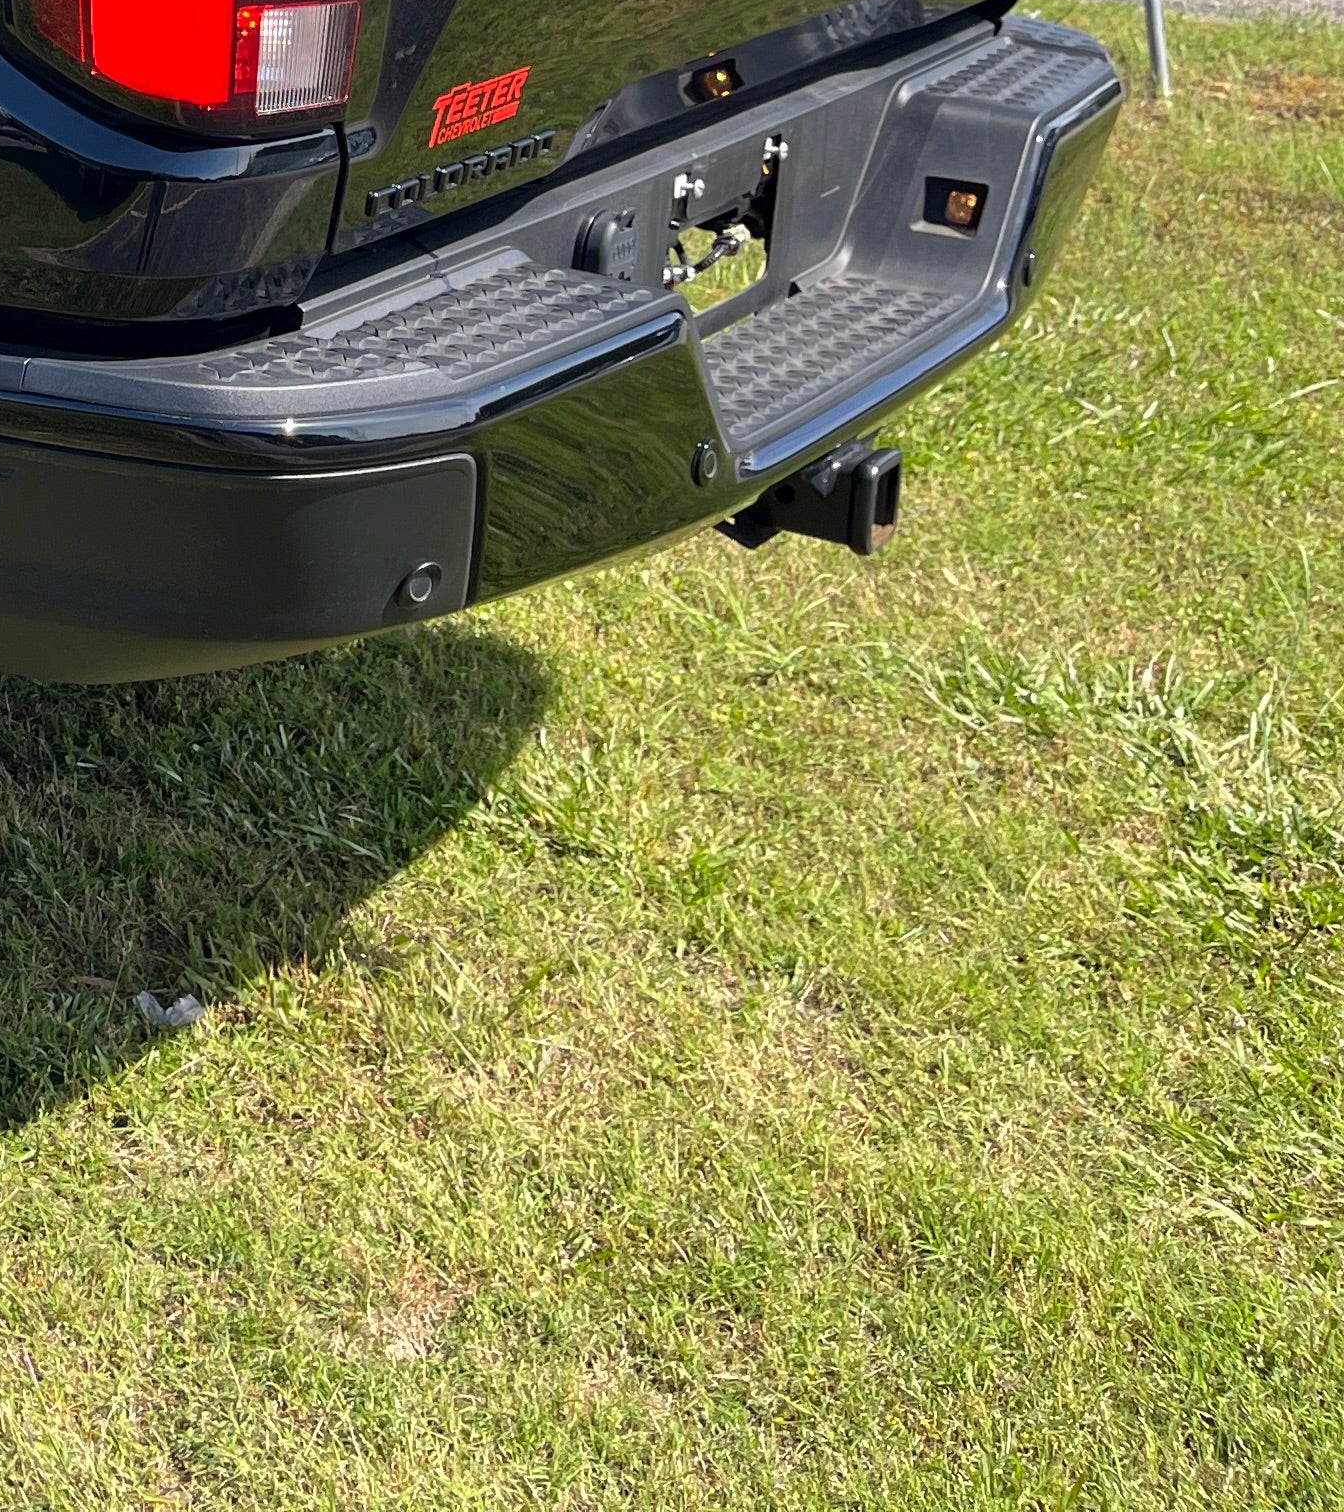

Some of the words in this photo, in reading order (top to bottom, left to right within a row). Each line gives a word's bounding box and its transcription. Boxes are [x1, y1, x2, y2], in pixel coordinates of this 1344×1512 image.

[429, 68, 531, 148] TEETER
[437, 111, 495, 144] CHEVROLET
[365, 130, 557, 217] COLORADO
